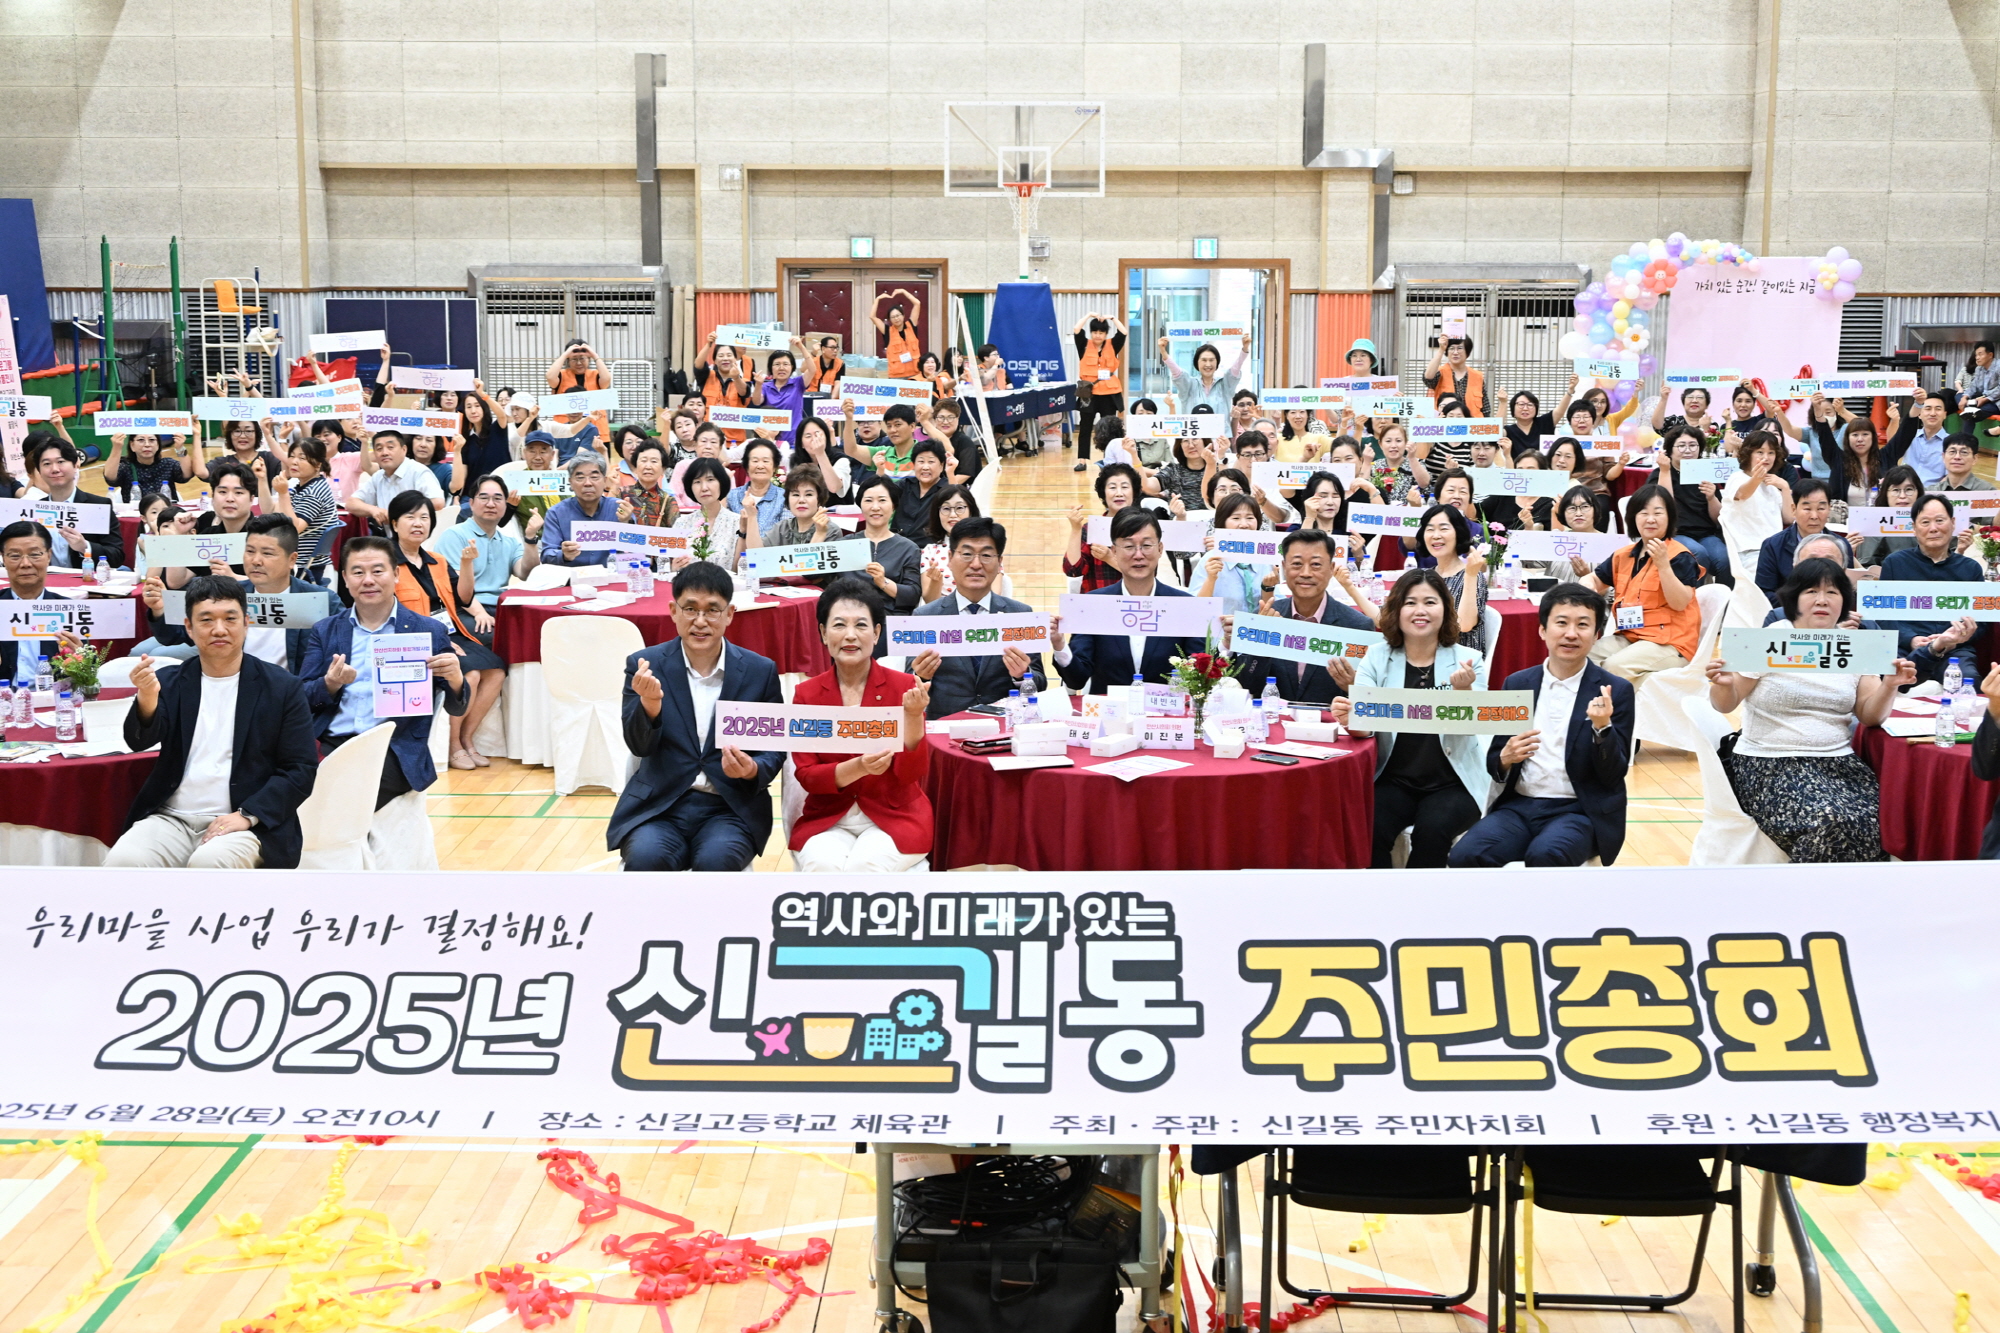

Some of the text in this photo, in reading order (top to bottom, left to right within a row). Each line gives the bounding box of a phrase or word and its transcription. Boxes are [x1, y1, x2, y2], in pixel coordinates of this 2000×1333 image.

[1695, 279, 1713, 291] 가치
[1716, 278, 1732, 294] 있는
[1736, 279, 1757, 294] 순간!
[1800, 278, 1816, 294] 지금
[734, 332, 771, 347] 신길동
[1007, 360, 1059, 371] OSUNG
[1588, 363, 1622, 379] 신길동
[1373, 402, 1414, 416] 신길동
[99, 417, 133, 428] 2025년
[366, 413, 456, 429] 2025년 신길동 주민총회
[1151, 420, 1200, 437] 신길동
[1412, 426, 1444, 436] 2025년
[20, 508, 79, 530] 신길동
[1350, 513, 1383, 526] 우리마을
[576, 530, 687, 550] 2025년 신길동 주민총회
[1219, 540, 1255, 555] 우리마을
[1257, 542, 1276, 556] 사업
[779, 550, 840, 573] 신길동
[32, 603, 91, 612] 역사와 미래가 있는
[268, 596, 283, 604] 있는
[1861, 595, 1907, 609] 우리마을
[1909, 595, 1932, 610] 사업
[1935, 595, 1970, 610] 우리가
[247, 604, 288, 625] 길동
[10, 611, 95, 637] 신길동
[892, 626, 1047, 644] 우리마을 사업 우리가 결정해요
[1236, 626, 1282, 647] 우리마을
[1283, 634, 1307, 651] 사업
[1308, 637, 1343, 657] 우리가
[1790, 633, 1850, 642] 역사와 미래가 있는
[1766, 641, 1853, 669] 신길동
[1354, 701, 1404, 719] 우리마을
[1435, 705, 1474, 721] 우리가
[1477, 705, 1529, 721] 결정해요
[722, 715, 898, 739] 2025년 신길동 주민총회
[776, 894, 1172, 938] 역사와 미래가 있는
[25, 906, 594, 955] 우리마을 사업 우리가 결정해요!
[93, 927, 1879, 1094] 2025년 신길동 주민총회
[0, 1103, 78, 1121] 25년
[85, 1104, 144, 1122] 6월
[149, 1105, 286, 1126] 28일(토)
[293, 1108, 441, 1128] 오전10시
[538, 1111, 602, 1130] 장소
[635, 1113, 837, 1134] 신길고등학교
[849, 1114, 952, 1135] 체육관
[1049, 1115, 1117, 1136] 주최
[1151, 1115, 1220, 1136] 주관
[1261, 1115, 1363, 1136] 신길동
[1375, 1114, 1546, 1136] 주민자치회
[1647, 1113, 1716, 1135] 후원
[1746, 1113, 1850, 1134] 신길동
